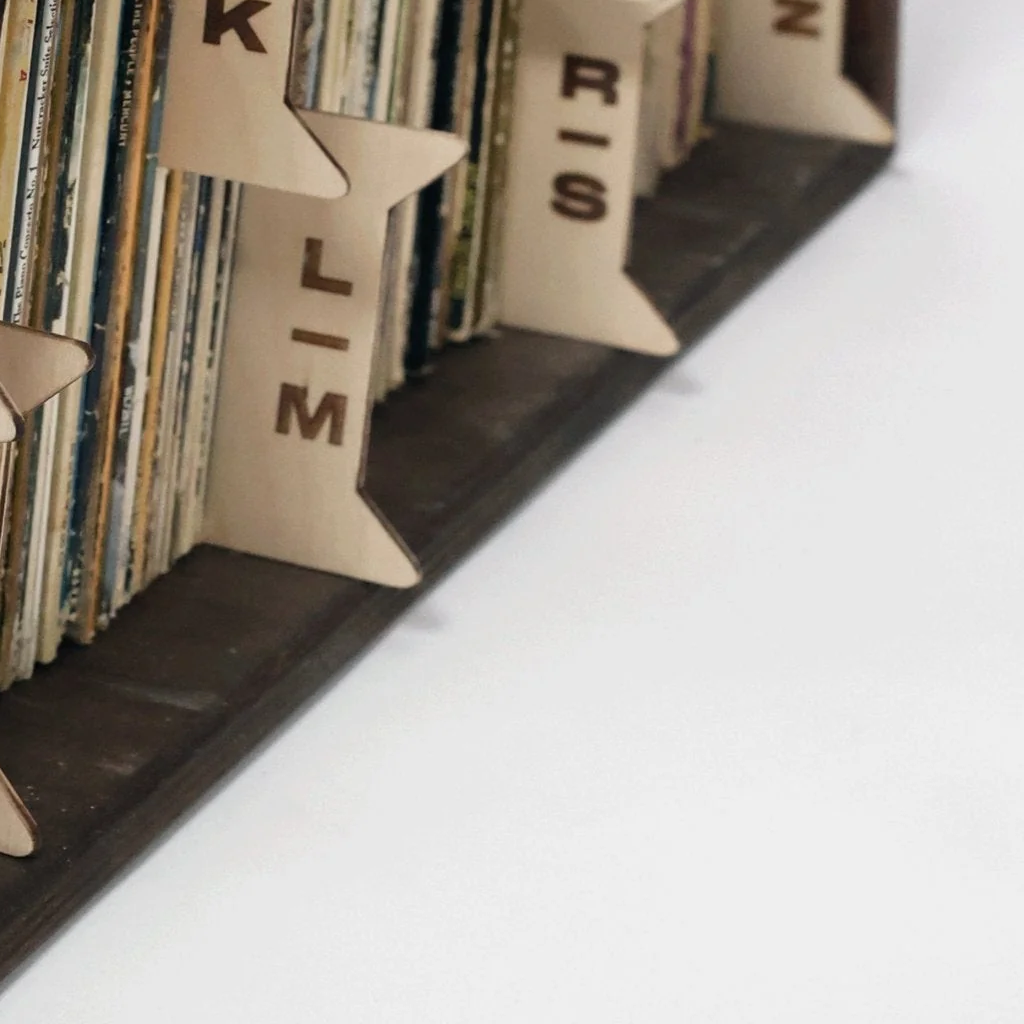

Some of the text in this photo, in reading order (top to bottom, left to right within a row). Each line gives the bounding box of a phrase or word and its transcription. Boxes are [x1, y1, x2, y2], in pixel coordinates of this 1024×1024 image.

[550, 53, 620, 223] R S
[275, 237, 353, 446] L M
